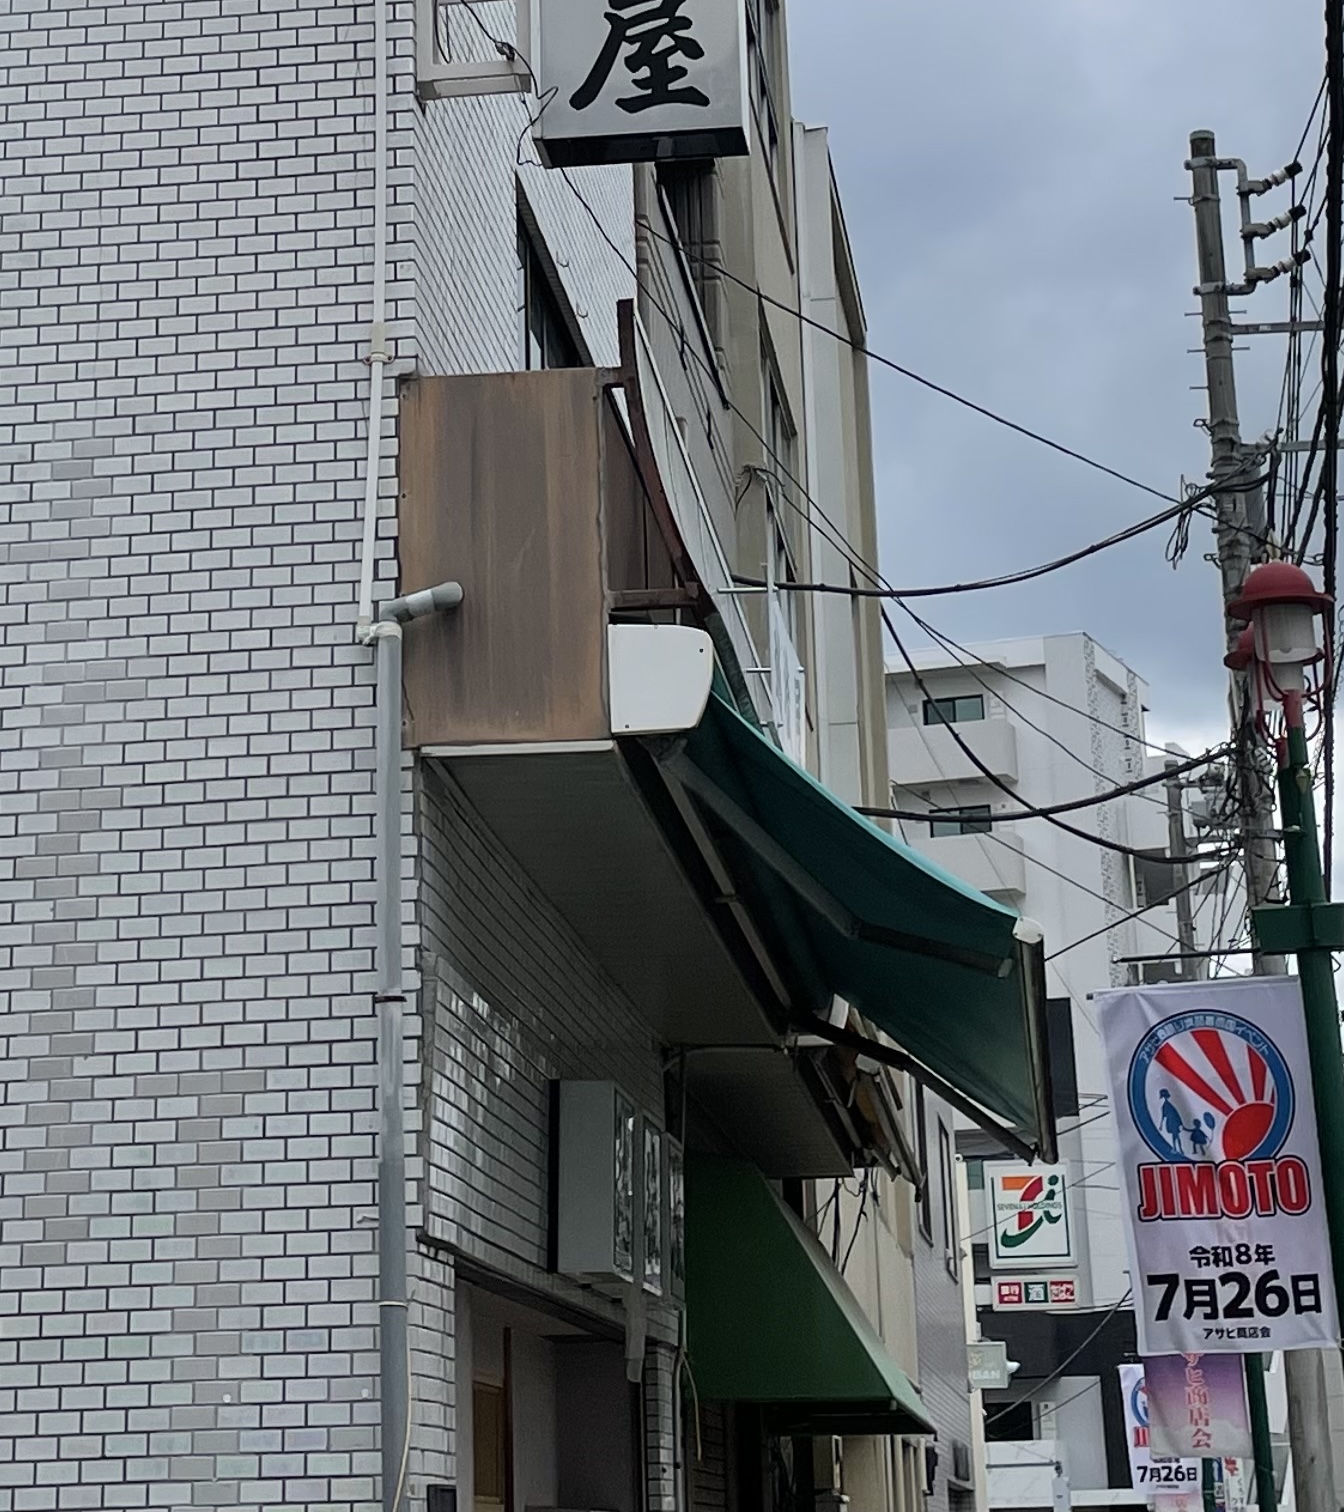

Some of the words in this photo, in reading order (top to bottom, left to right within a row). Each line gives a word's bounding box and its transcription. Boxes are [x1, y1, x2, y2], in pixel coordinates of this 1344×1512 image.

[1140, 1157, 1310, 1220] JIMOTO
[1189, 1244, 1275, 1268] 令和8年
[1147, 1269, 1322, 1322] 7月26日
[1137, 1465, 1197, 1483] 7月26日
